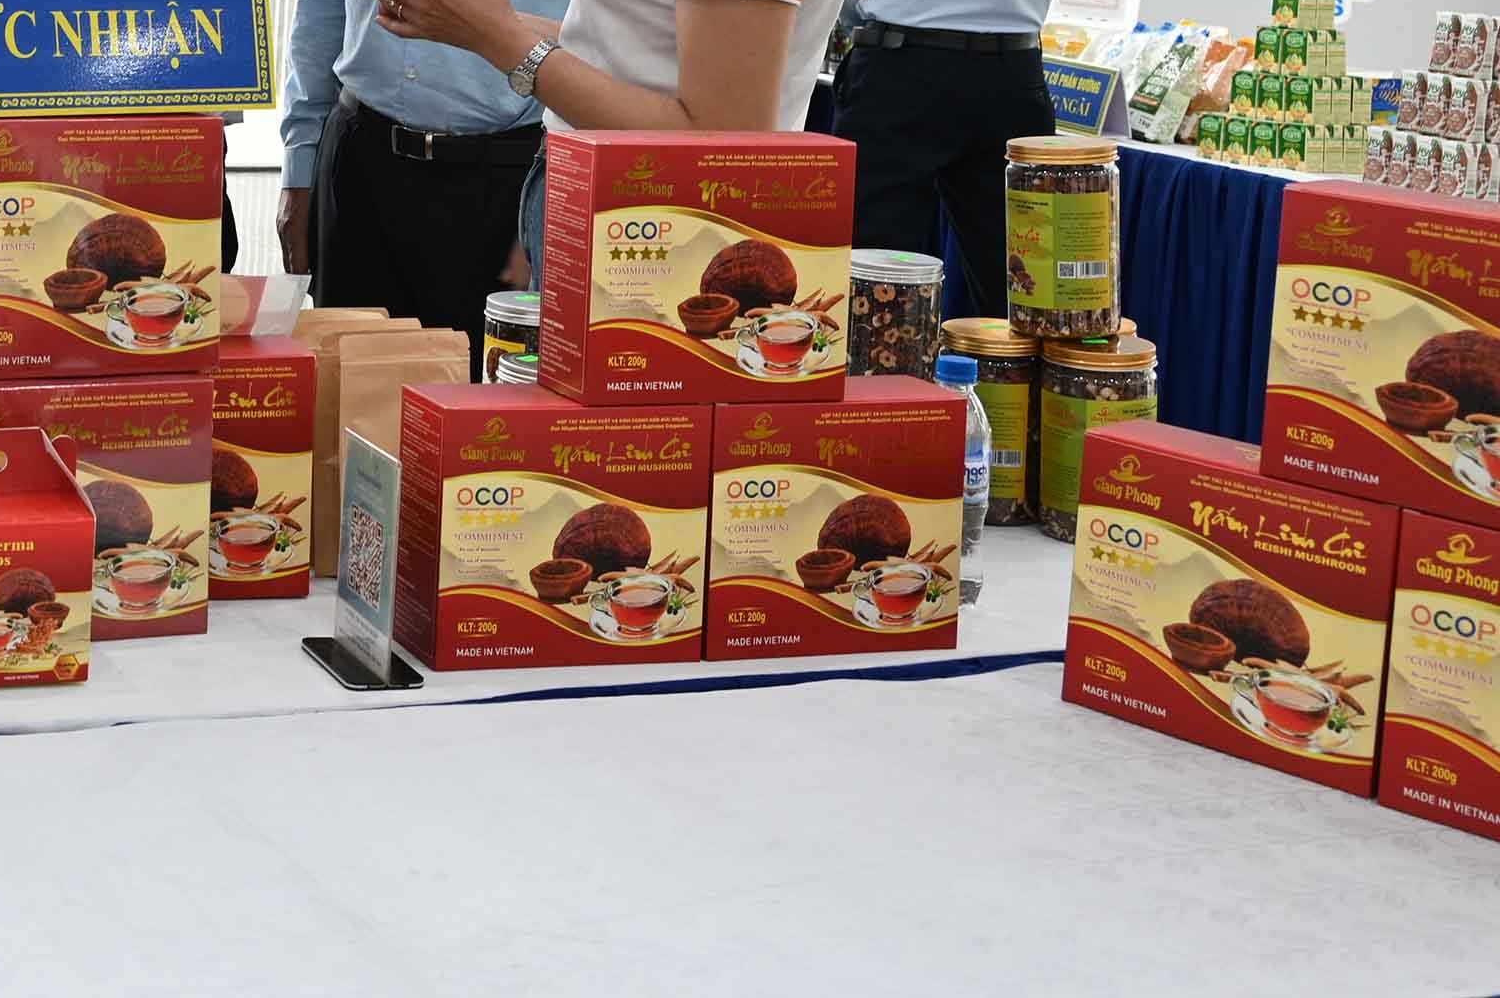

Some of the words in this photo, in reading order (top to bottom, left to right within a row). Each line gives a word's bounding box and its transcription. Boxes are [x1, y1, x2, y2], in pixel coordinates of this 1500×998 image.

[53, 1, 224, 69] NHUẬN
[607, 221, 672, 240] OCOP
[1291, 278, 1371, 310] OCOP
[0, 356, 9, 365] IN
[12, 355, 51, 365] VIETNAM
[608, 356, 627, 367] KLT:
[628, 355, 647, 369] 200g
[607, 381, 631, 391] MADE
[634, 381, 643, 391] IN
[645, 381, 682, 391] VIETNAM
[243, 409, 296, 418] MUSHROOM
[135, 437, 192, 449] MUSHROOM
[1286, 425, 1309, 442] KLT:
[1310, 429, 1334, 448] 200g
[638, 462, 692, 472] MUSHROOM
[1284, 454, 1314, 472] MADE
[1316, 462, 1328, 474] IN
[1330, 465, 1379, 485] VIETNAM
[457, 487, 524, 506] OCOP
[727, 480, 790, 499] OCOP
[1125, 486, 1162, 510] Phong
[1090, 518, 1158, 550] OCOP
[1254, 540, 1292, 559] REISHI
[1295, 550, 1367, 576] MUSHROOM
[1416, 557, 1452, 583] Giang
[1456, 568, 1499, 595] Phong
[458, 623, 477, 633] KLT:
[478, 622, 497, 635] 200g
[728, 612, 746, 623] KLT:
[747, 612, 765, 624] 200g
[1411, 604, 1497, 642] OCOP
[457, 647, 481, 657] MADE
[484, 647, 493, 656] IN
[494, 646, 534, 656] VIETNAM
[727, 637, 751, 647] MADE
[753, 637, 762, 645] IN
[764, 635, 800, 645] VIETNAM
[1084, 655, 1103, 673] KLT:
[1106, 662, 1126, 682] 200g
[1082, 682, 1109, 700] MADE
[1111, 690, 1122, 703] IN
[1124, 694, 1167, 719] VIETNAM
[1406, 757, 1429, 776] KLT:
[1432, 764, 1457, 786] 200g
[1403, 786, 1435, 806] MADE
[1438, 797, 1450, 809] IN
